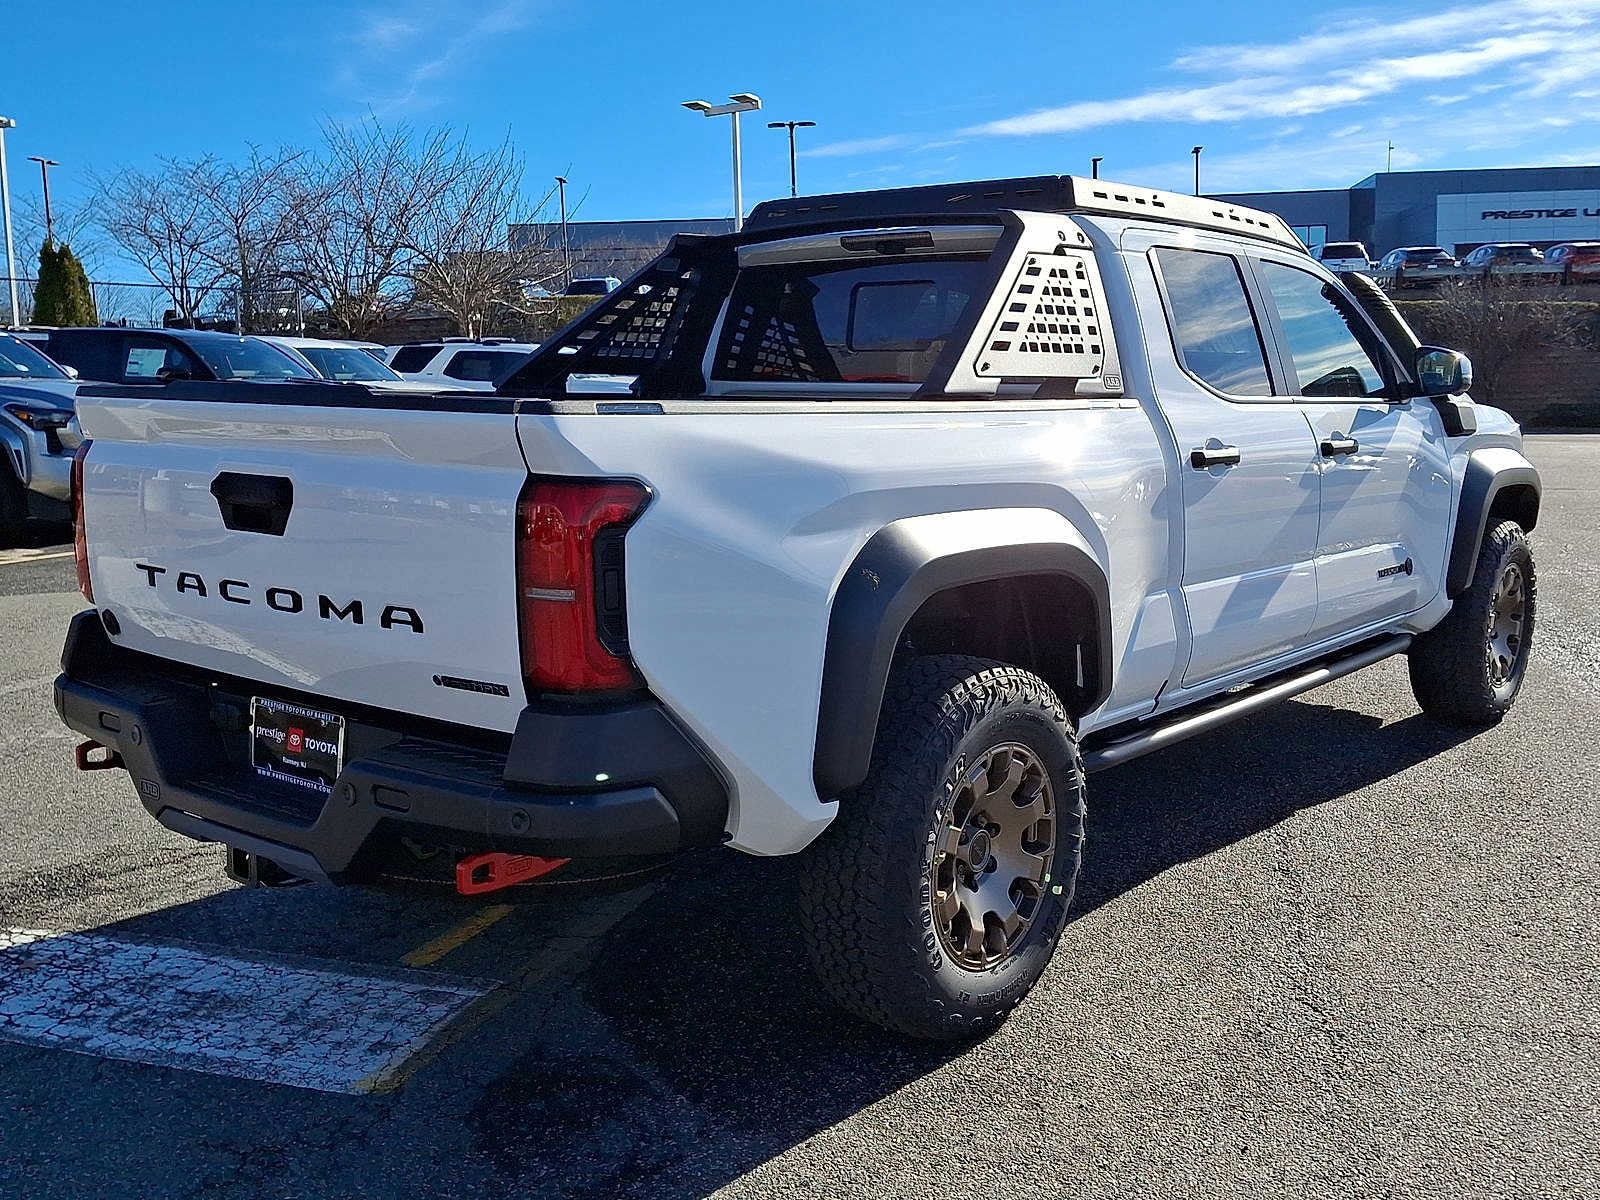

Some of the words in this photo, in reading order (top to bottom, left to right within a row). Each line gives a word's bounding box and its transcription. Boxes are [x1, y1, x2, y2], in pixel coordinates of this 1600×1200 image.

[1481, 208, 1577, 220] PRESTIGE
[135, 562, 425, 635] TACOMA
[260, 699, 285, 711] PRESTIGE
[285, 706, 306, 716] TOYOTA
[256, 726, 286, 743] prestige
[305, 737, 337, 755] TOYOTA
